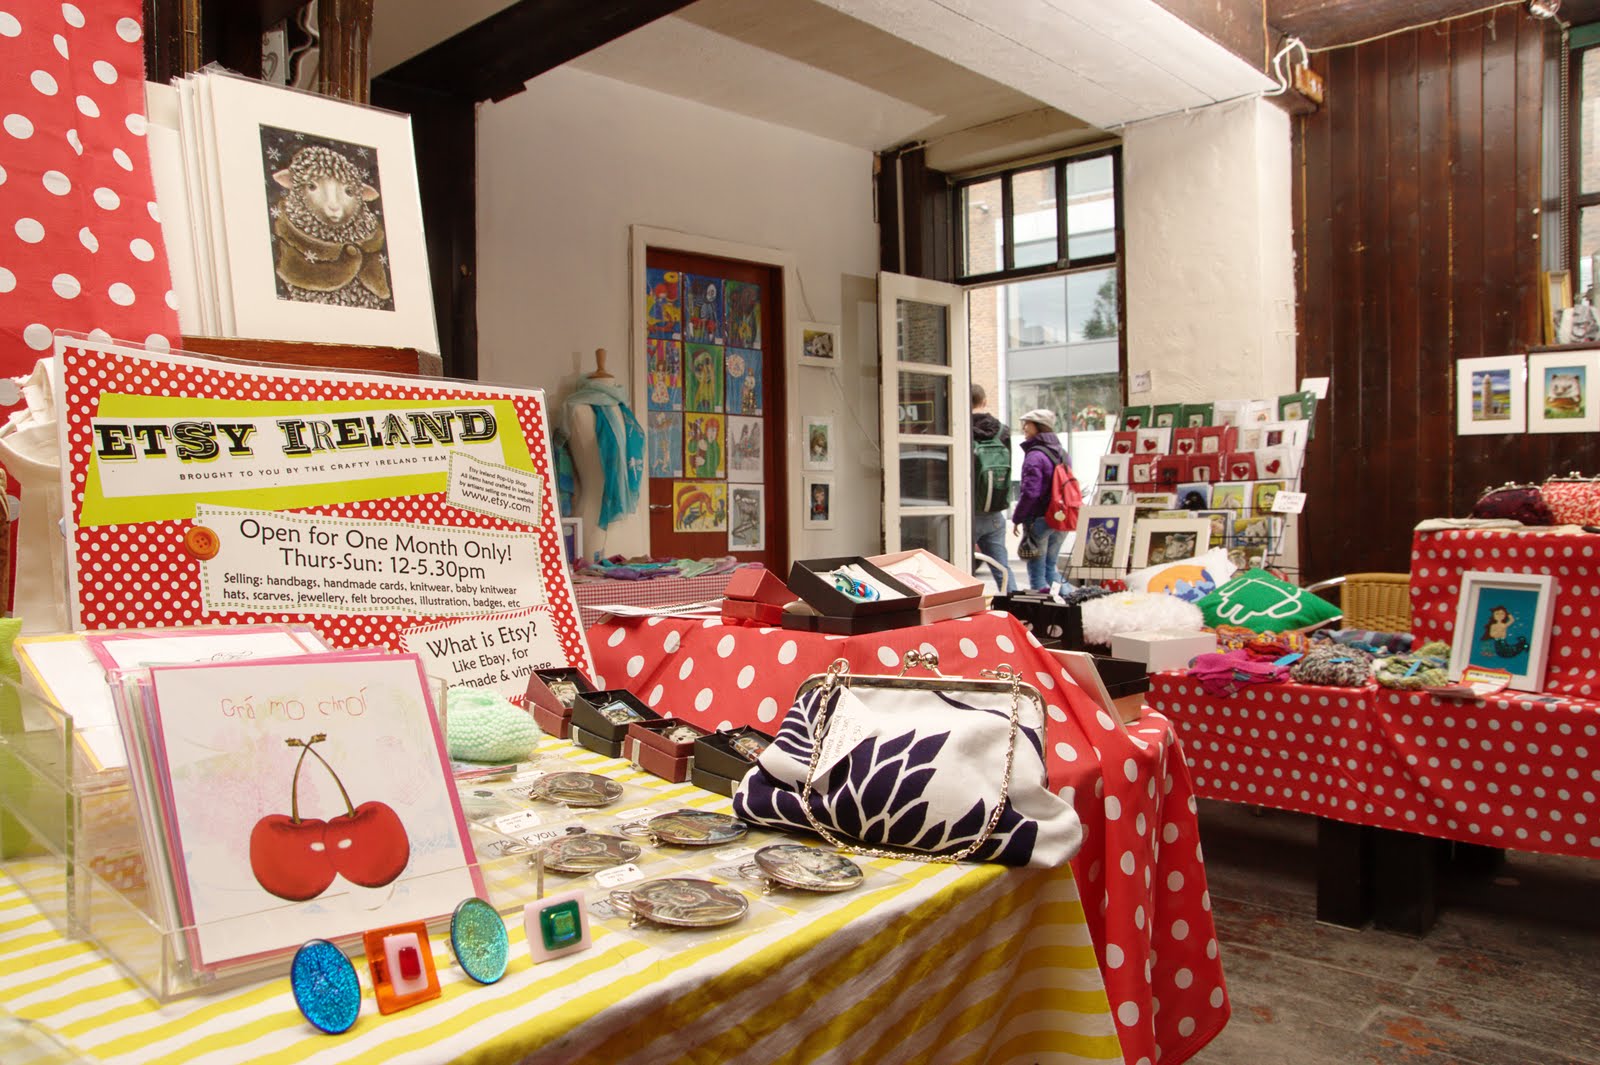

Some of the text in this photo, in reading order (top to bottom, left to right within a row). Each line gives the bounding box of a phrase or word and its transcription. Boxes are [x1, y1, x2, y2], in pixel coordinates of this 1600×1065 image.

[93, 408, 498, 463] ETSY IRELAND
[179, 471, 234, 480] BROUGHT
[330, 460, 370, 471] CRAFTY
[375, 457, 418, 466] IRELAND
[479, 470, 496, 478] Ireland
[515, 480, 527, 488] Shop
[495, 480, 511, 490] crafted
[517, 488, 534, 496] Ireland
[516, 496, 534, 504] website
[461, 488, 532, 513] www.etsy.com
[239, 518, 512, 564] Open for One Month Only!
[279, 547, 486, 582] Thurs-Sun: 12-5.30pm
[224, 572, 517, 596] Selling: handbags, handmade cards, knitwear, baby knitwear
[223, 588, 521, 610] hats, scarves, jewellery, felt brooches, illustration, badges, etc
[426, 621, 538, 658] What is Etsy?
[452, 646, 529, 673] Like Ebay, for
[500, 669, 511, 681] &
